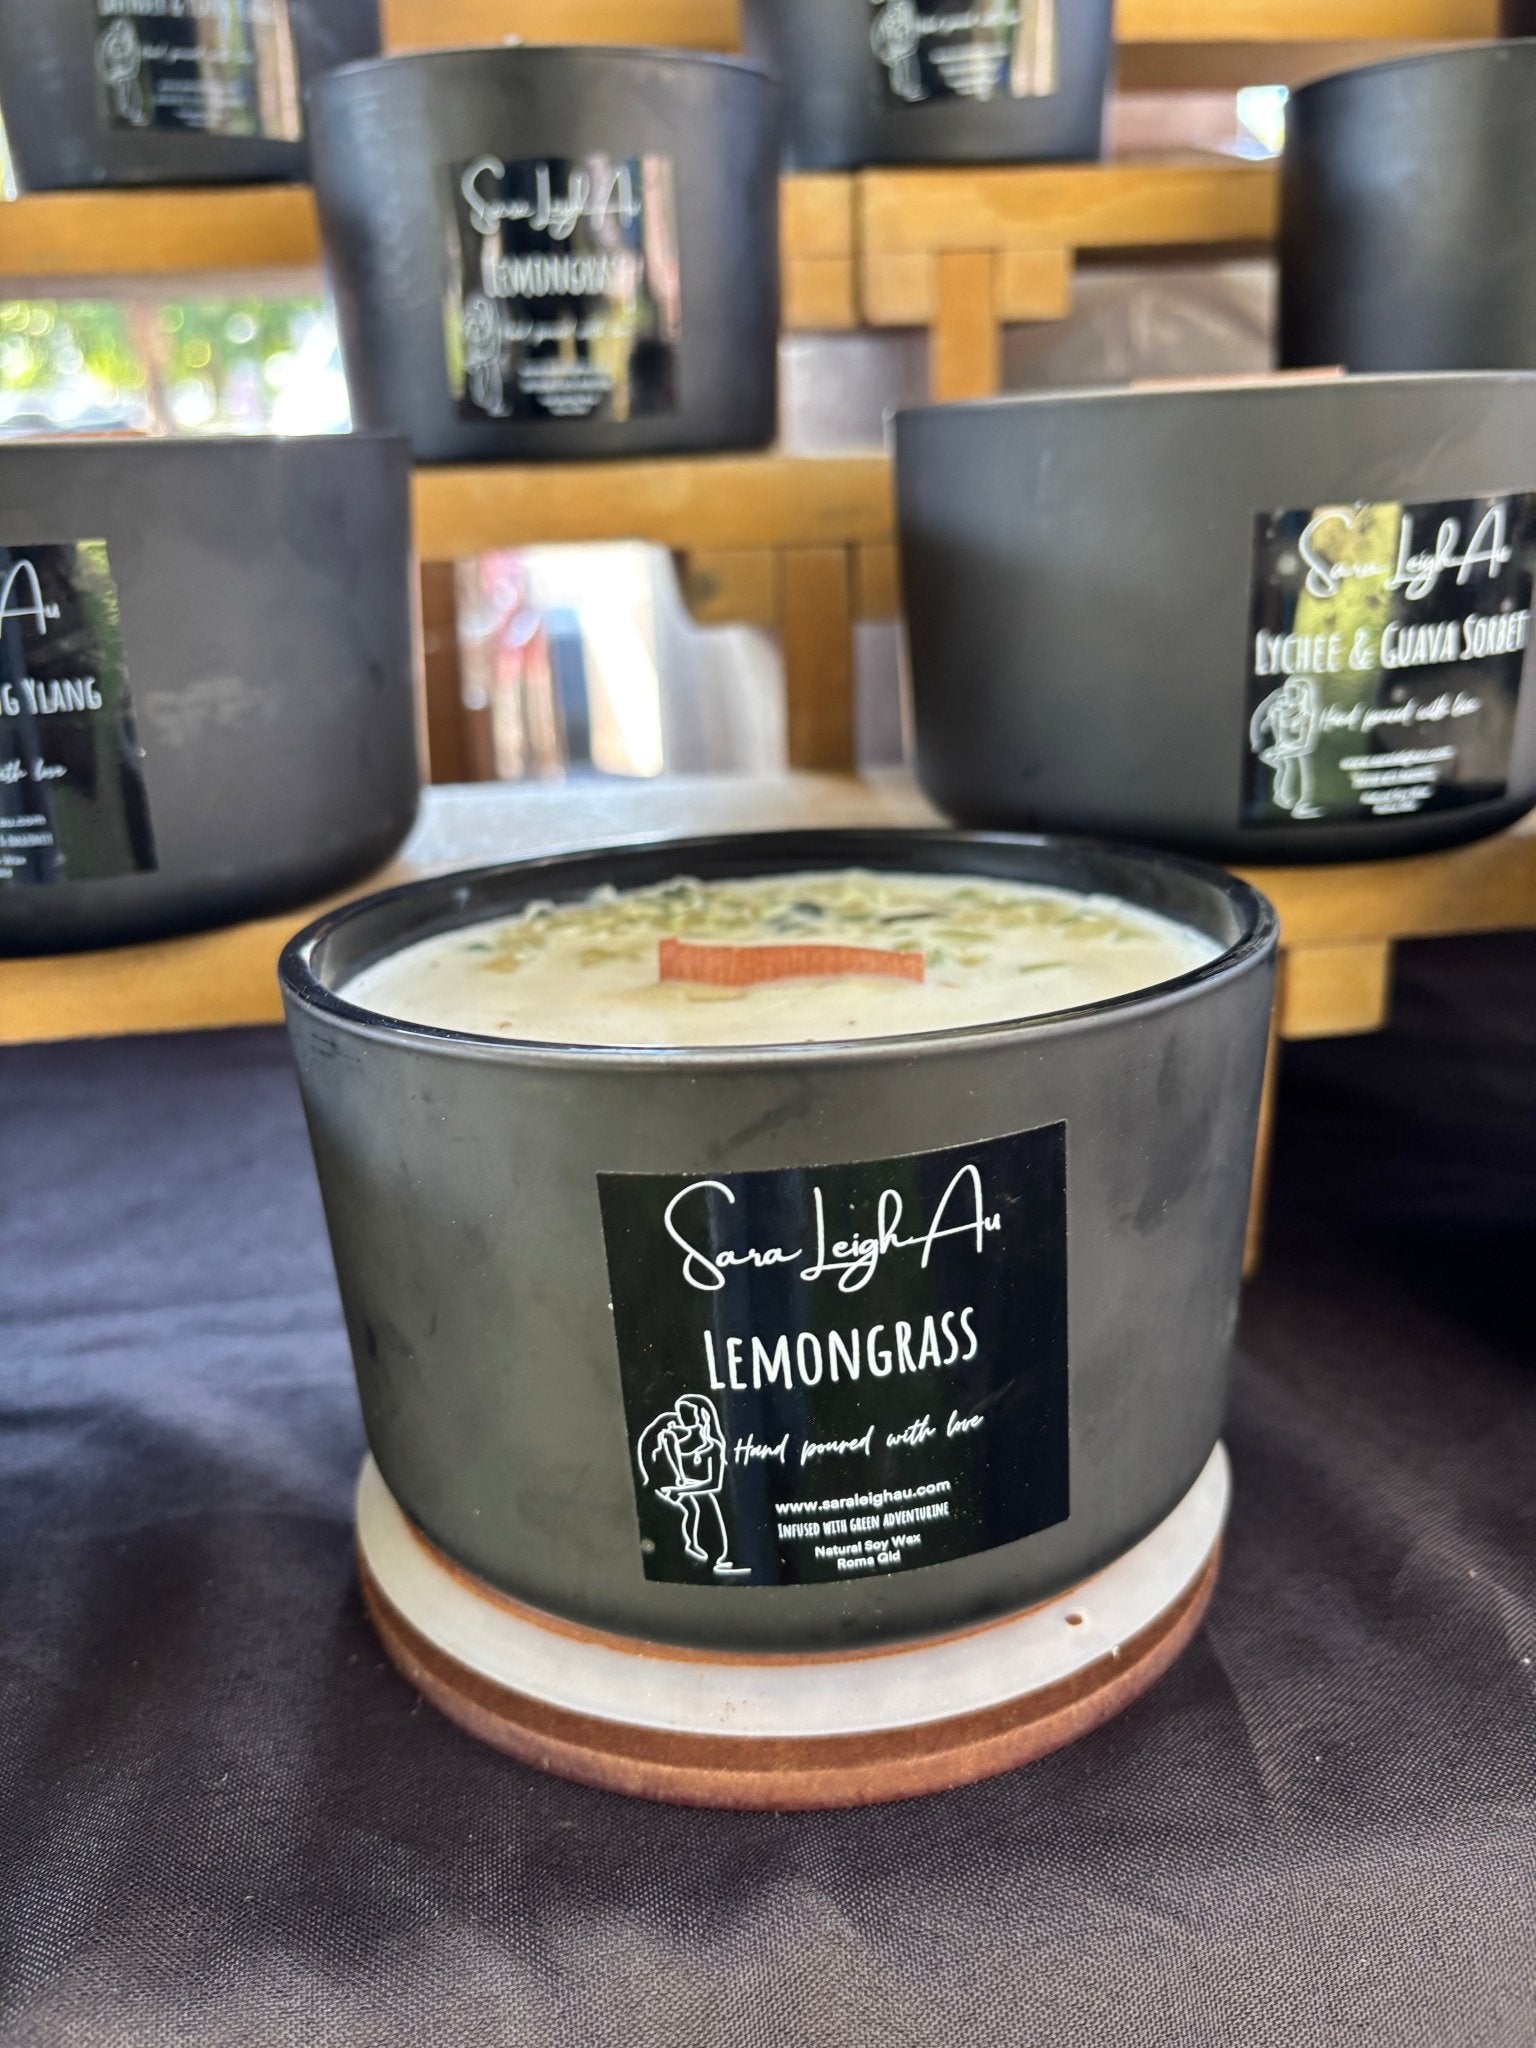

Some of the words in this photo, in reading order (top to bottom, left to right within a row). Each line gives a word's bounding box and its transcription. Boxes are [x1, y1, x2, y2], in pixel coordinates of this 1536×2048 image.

[1299, 510, 1389, 598] Sara
[1384, 514, 1462, 600] Leigh
[1457, 503, 1512, 585] Au
[1255, 627, 1344, 675] LYCHEE
[1349, 627, 1376, 671] &
[1380, 620, 1461, 669] GUAVA
[1460, 609, 1531, 660] SORBET
[20, 676, 103, 715] YLANG
[665, 1180, 802, 1291] Sara
[800, 1187, 915, 1292] Leigh
[916, 1164, 1001, 1268] Au
[704, 1306, 979, 1391] LEMONGRASS
[734, 1433, 789, 1466] Hand
[800, 1425, 875, 1466] poured
[887, 1414, 936, 1447] with
[946, 1409, 984, 1438] love
[775, 1480, 951, 1514] www.saraleighau.com
[778, 1521, 820, 1538] INFUSED
[823, 1518, 847, 1536] WITH
[850, 1514, 880, 1532] GREEN
[883, 1502, 949, 1527] ADVENTURINE
[815, 1541, 862, 1557] Natural
[864, 1539, 889, 1552] Soy
[891, 1533, 921, 1546] Wax
[837, 1557, 874, 1571] Roma
[877, 1550, 901, 1564] Qld
